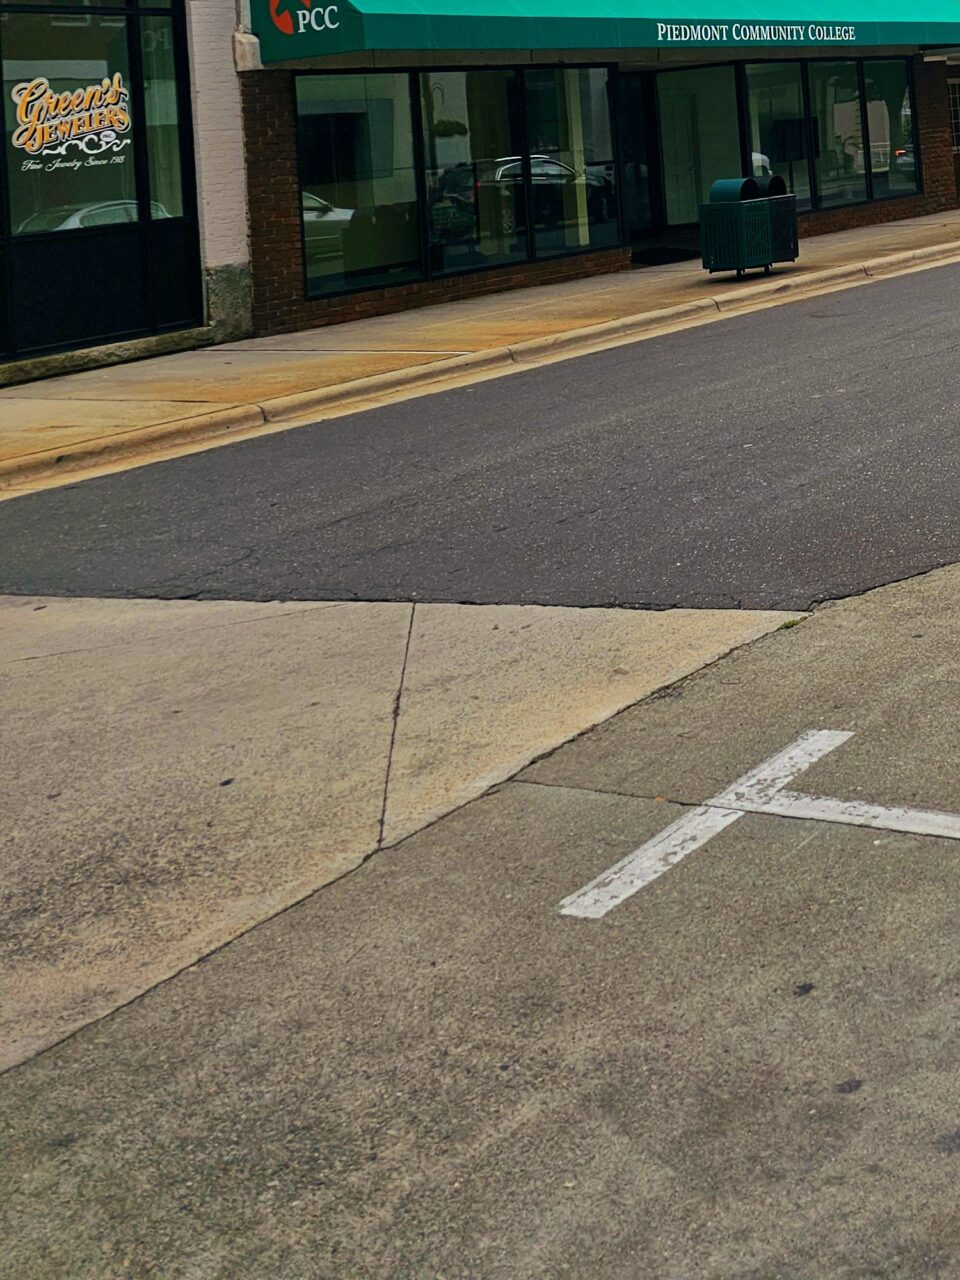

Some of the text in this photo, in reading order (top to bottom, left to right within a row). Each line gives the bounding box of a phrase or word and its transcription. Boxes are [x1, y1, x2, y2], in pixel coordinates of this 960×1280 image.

[296, 5, 340, 33] PCC
[656, 22, 856, 41] PIEDMONT COMMUNITY COLLEGE
[11, 72, 129, 148] Green's
[25, 103, 131, 154] JEWELERS
[21, 159, 43, 171] Fine
[45, 158, 82, 172] Jewelry
[84, 155, 108, 167] Since
